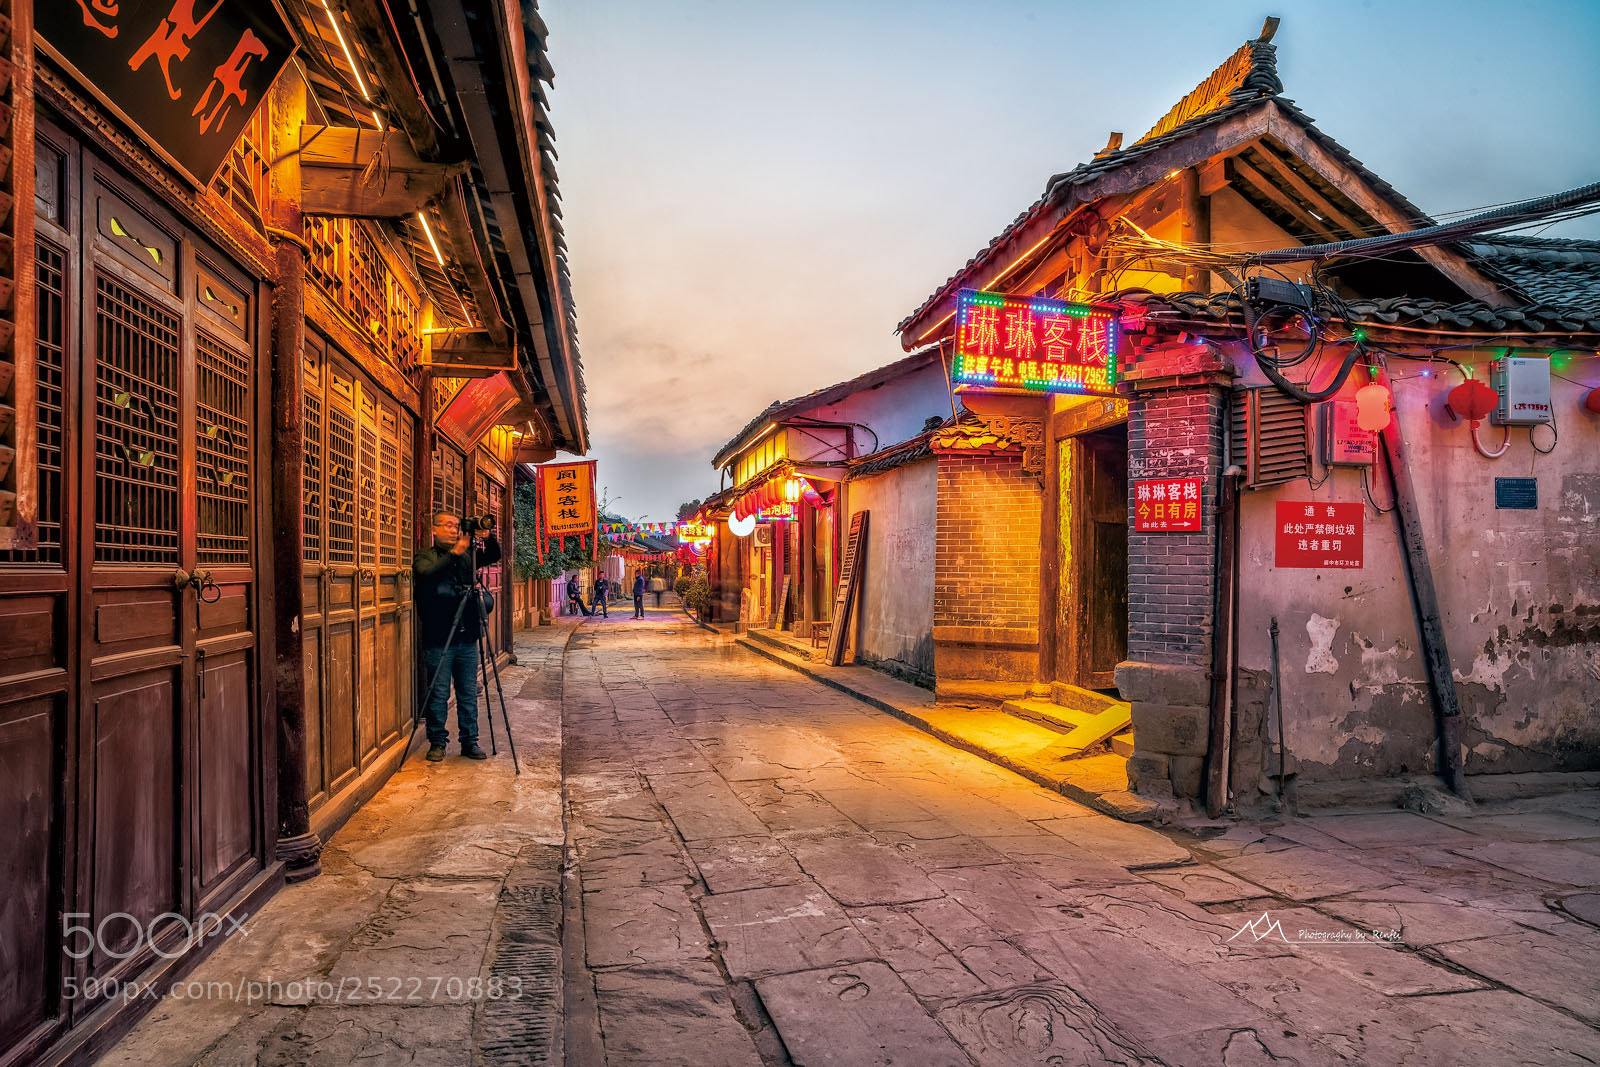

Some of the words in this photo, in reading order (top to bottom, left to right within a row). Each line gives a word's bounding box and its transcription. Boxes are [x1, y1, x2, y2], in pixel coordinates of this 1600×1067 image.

[966, 305, 1108, 366] 琳琳客栈
[1137, 482, 1198, 501] 琳琳客栈
[1138, 501, 1197, 519] 今日有房
[1304, 505, 1336, 517] 通告
[1142, 520, 1168, 529] 由此去
[1283, 522, 1356, 536] 此处严禁倒垃圾
[1297, 539, 1342, 552] 违者重罚
